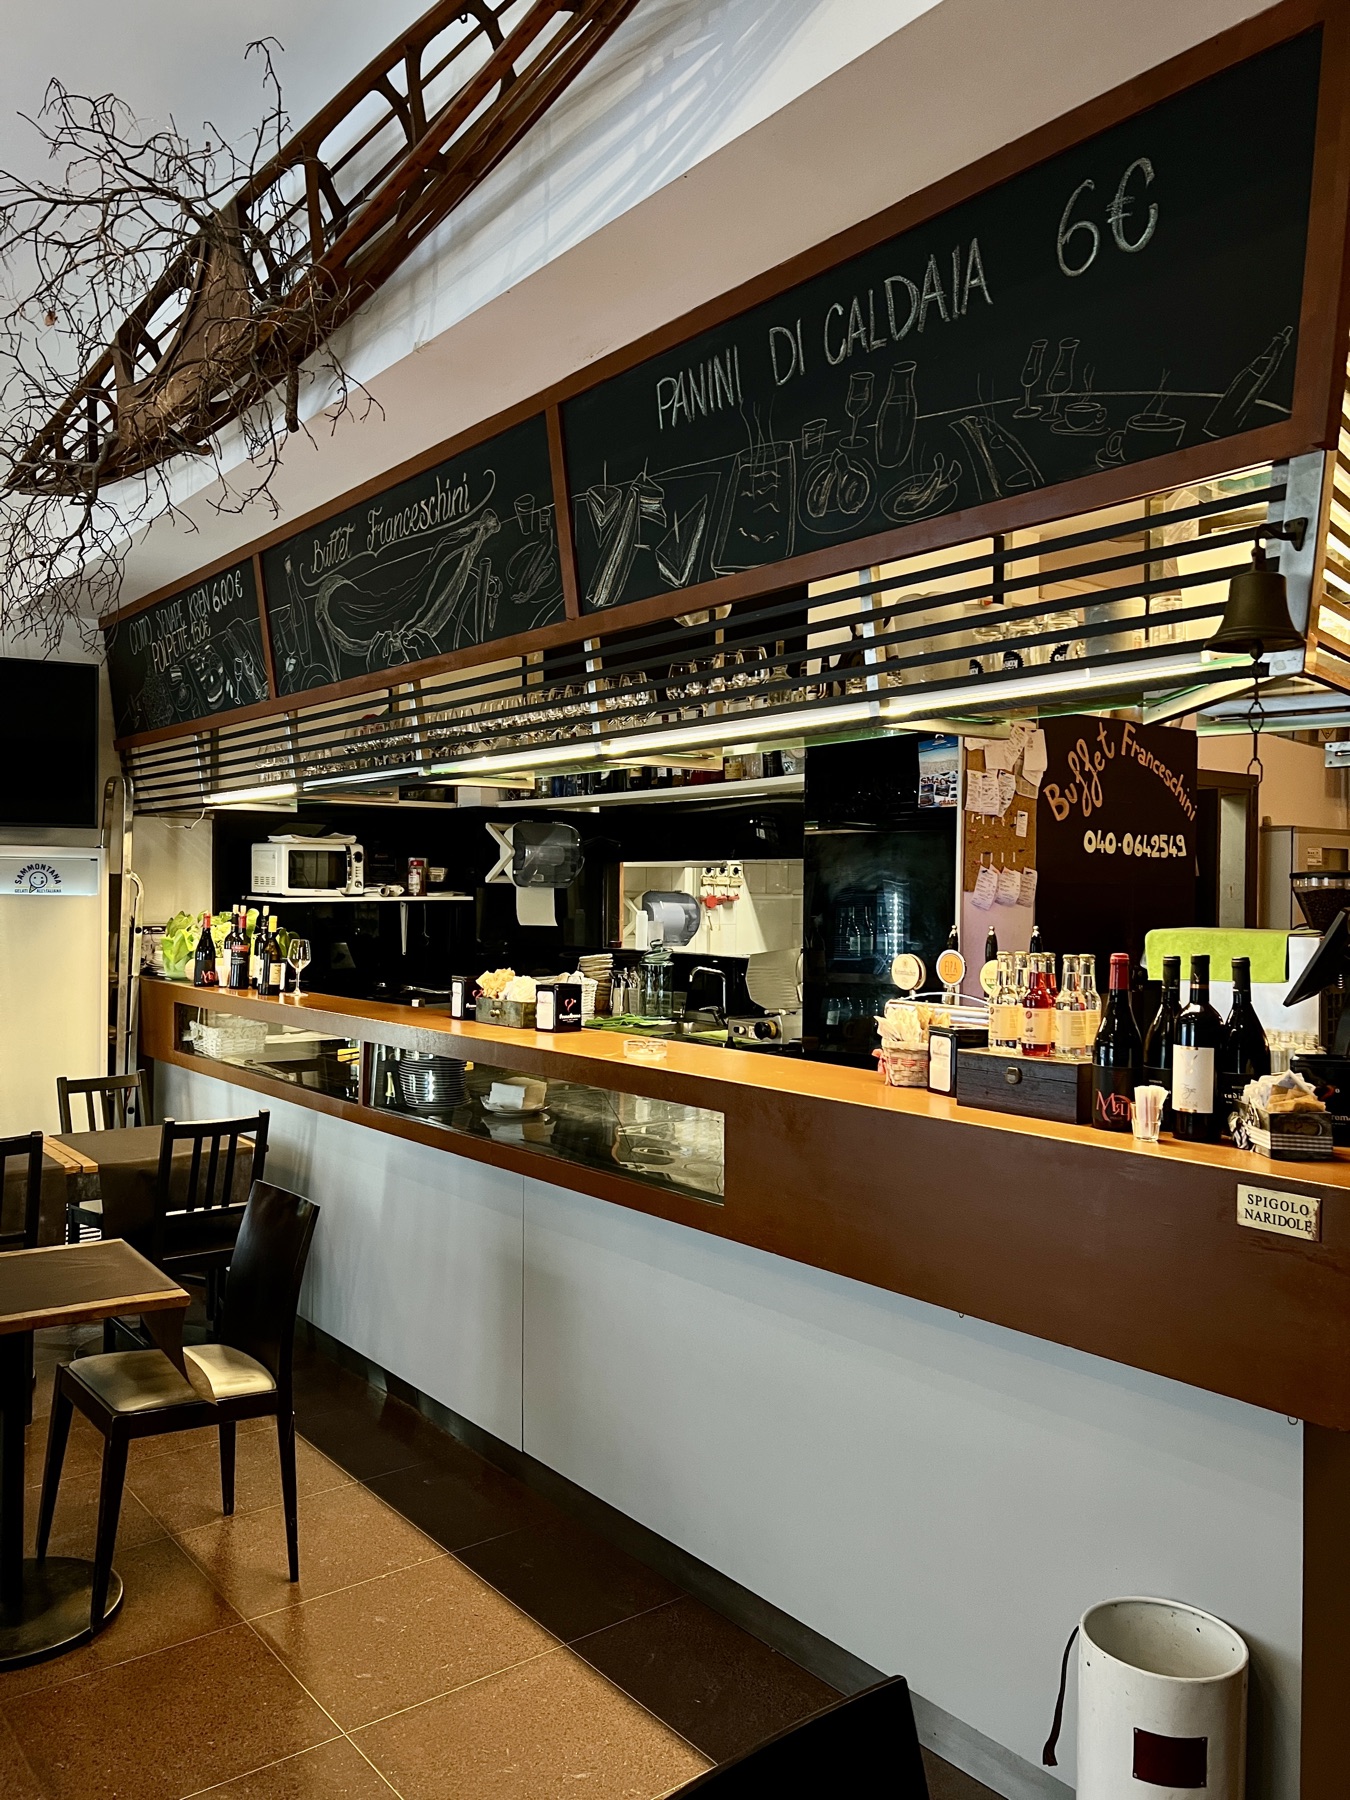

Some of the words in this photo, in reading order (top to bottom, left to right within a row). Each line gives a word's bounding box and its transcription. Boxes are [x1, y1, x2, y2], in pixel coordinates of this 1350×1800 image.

[656, 344, 743, 432] PANINI
[768, 317, 806, 387] DI
[823, 236, 994, 366] CALDAIA
[366, 472, 471, 553] Franceschini
[155, 599, 186, 640] SENAPE
[187, 584, 211, 624] KREN
[151, 625, 191, 675] POLPETTE
[1042, 721, 1116, 822] Buffet
[1120, 722, 1198, 822] Franceschini
[14, 863, 62, 885] SAMMONTANA
[1244, 1208, 1313, 1233] NARIDOLE
[1247, 1193, 1309, 1216] SPIGOLO
